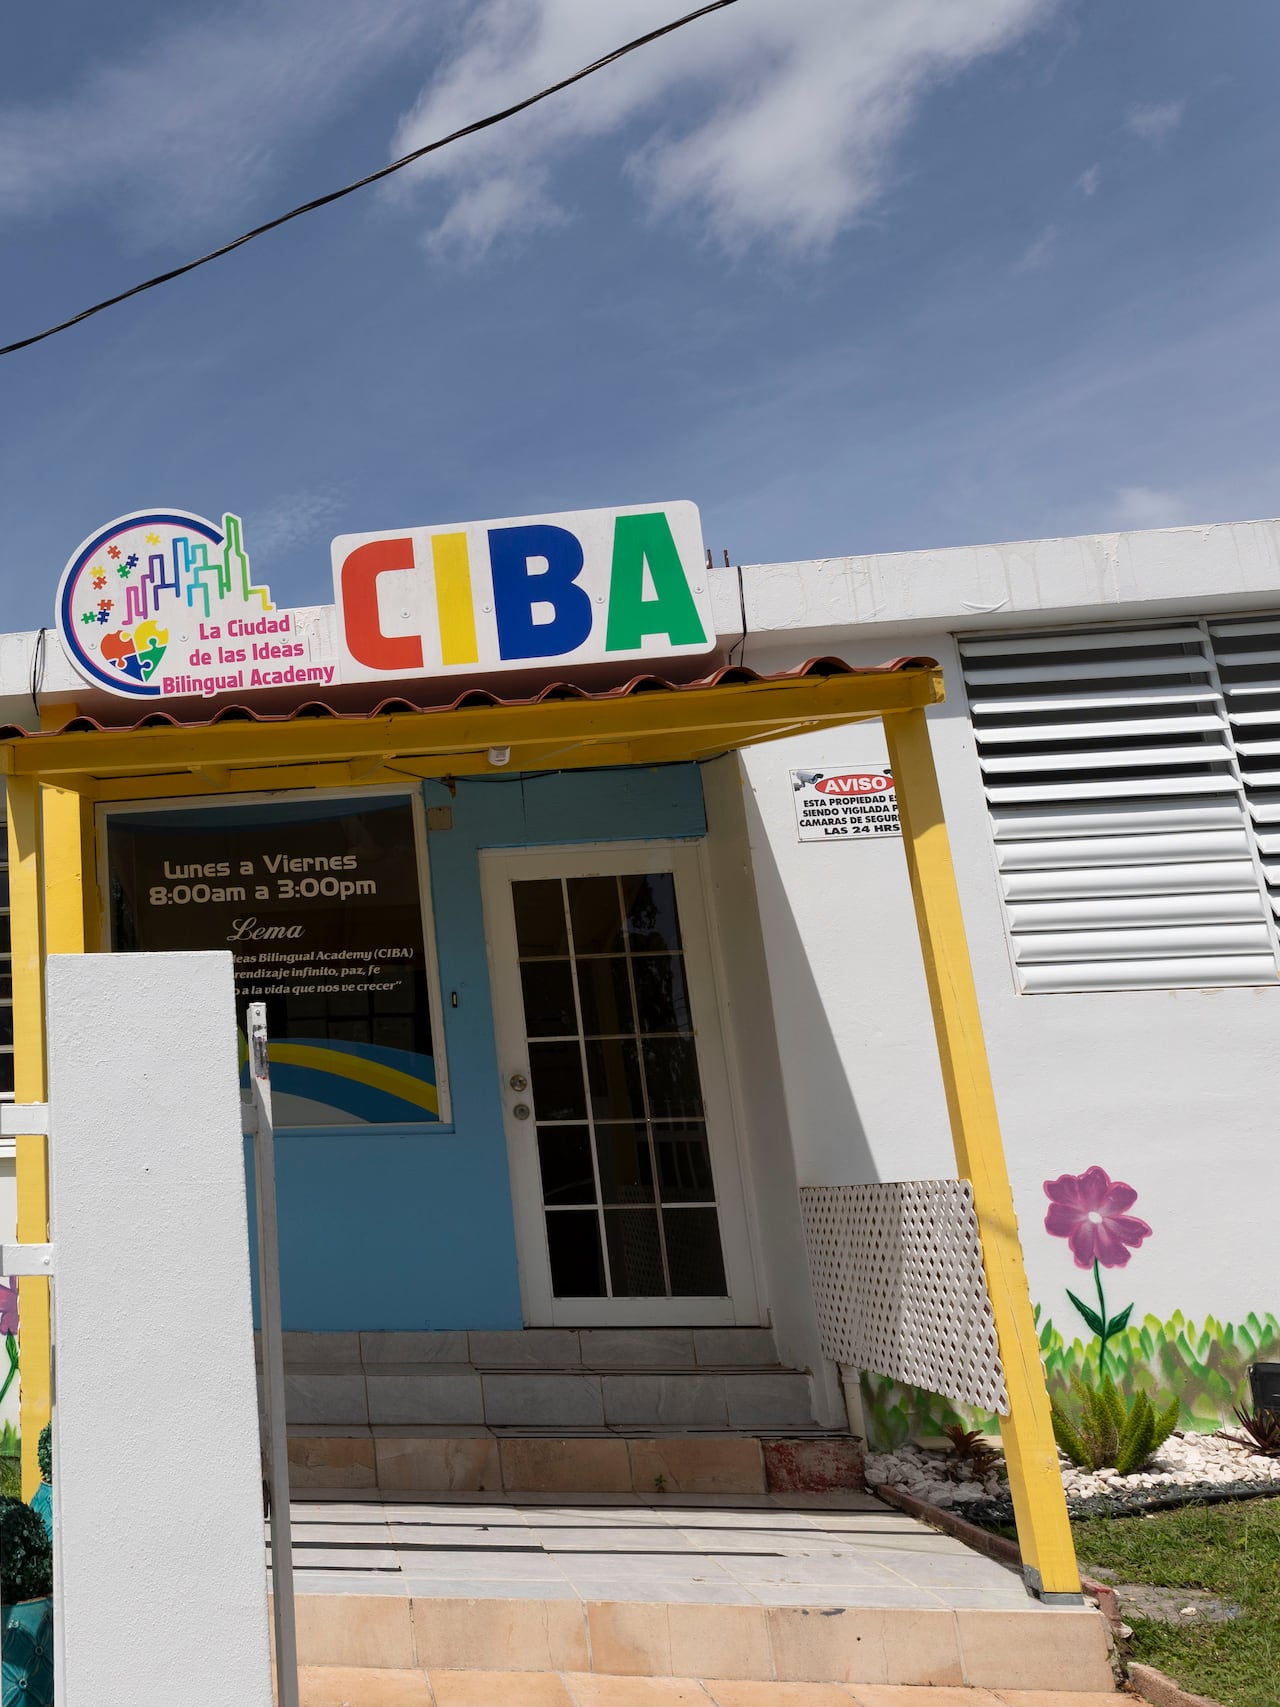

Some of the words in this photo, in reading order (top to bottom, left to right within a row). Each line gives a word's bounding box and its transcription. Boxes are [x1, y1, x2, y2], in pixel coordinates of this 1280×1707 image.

[341, 511, 708, 671] CIBA
[199, 623, 221, 641] La
[227, 614, 290, 637] Ciudad
[189, 649, 212, 666] de
[218, 646, 246, 664] las
[252, 642, 304, 660] Ideas
[162, 670, 244, 695] Bilingual
[250, 664, 335, 687] Academy
[824, 776, 887, 793] AVISO
[803, 799, 827, 808] ESTA
[829, 795, 886, 806] PROPIEDAD
[802, 808, 839, 817] SIENDO
[841, 805, 890, 815] VIGILADA
[799, 816, 848, 827] CAMARAS
[850, 816, 863, 824] DE
[865, 814, 899, 823] SEGUR
[824, 827, 848, 835] LAS
[852, 826, 871, 834] 24
[164, 861, 231, 880] Lunes
[239, 860, 254, 876] a
[262, 853, 358, 874] Viernes
[149, 883, 246, 906] 8:00am
[254, 882, 270, 900] a
[277, 876, 377, 900] 3:00pm
[226, 917, 305, 941] Lema
[233, 954, 256, 963] eas
[258, 952, 315, 964] Bilingual
[316, 950, 372, 961] Academy
[373, 947, 414, 959] (CIBA)
[234, 968, 290, 979] rendizaje
[291, 966, 339, 978] infinito,
[340, 966, 366, 977] paz,
[367, 964, 381, 976] fe
[241, 987, 249, 995] a
[251, 985, 263, 995] la
[264, 984, 291, 994] vida
[292, 985, 315, 995] que
[317, 984, 340, 993] nos
[341, 983, 355, 992] ve
